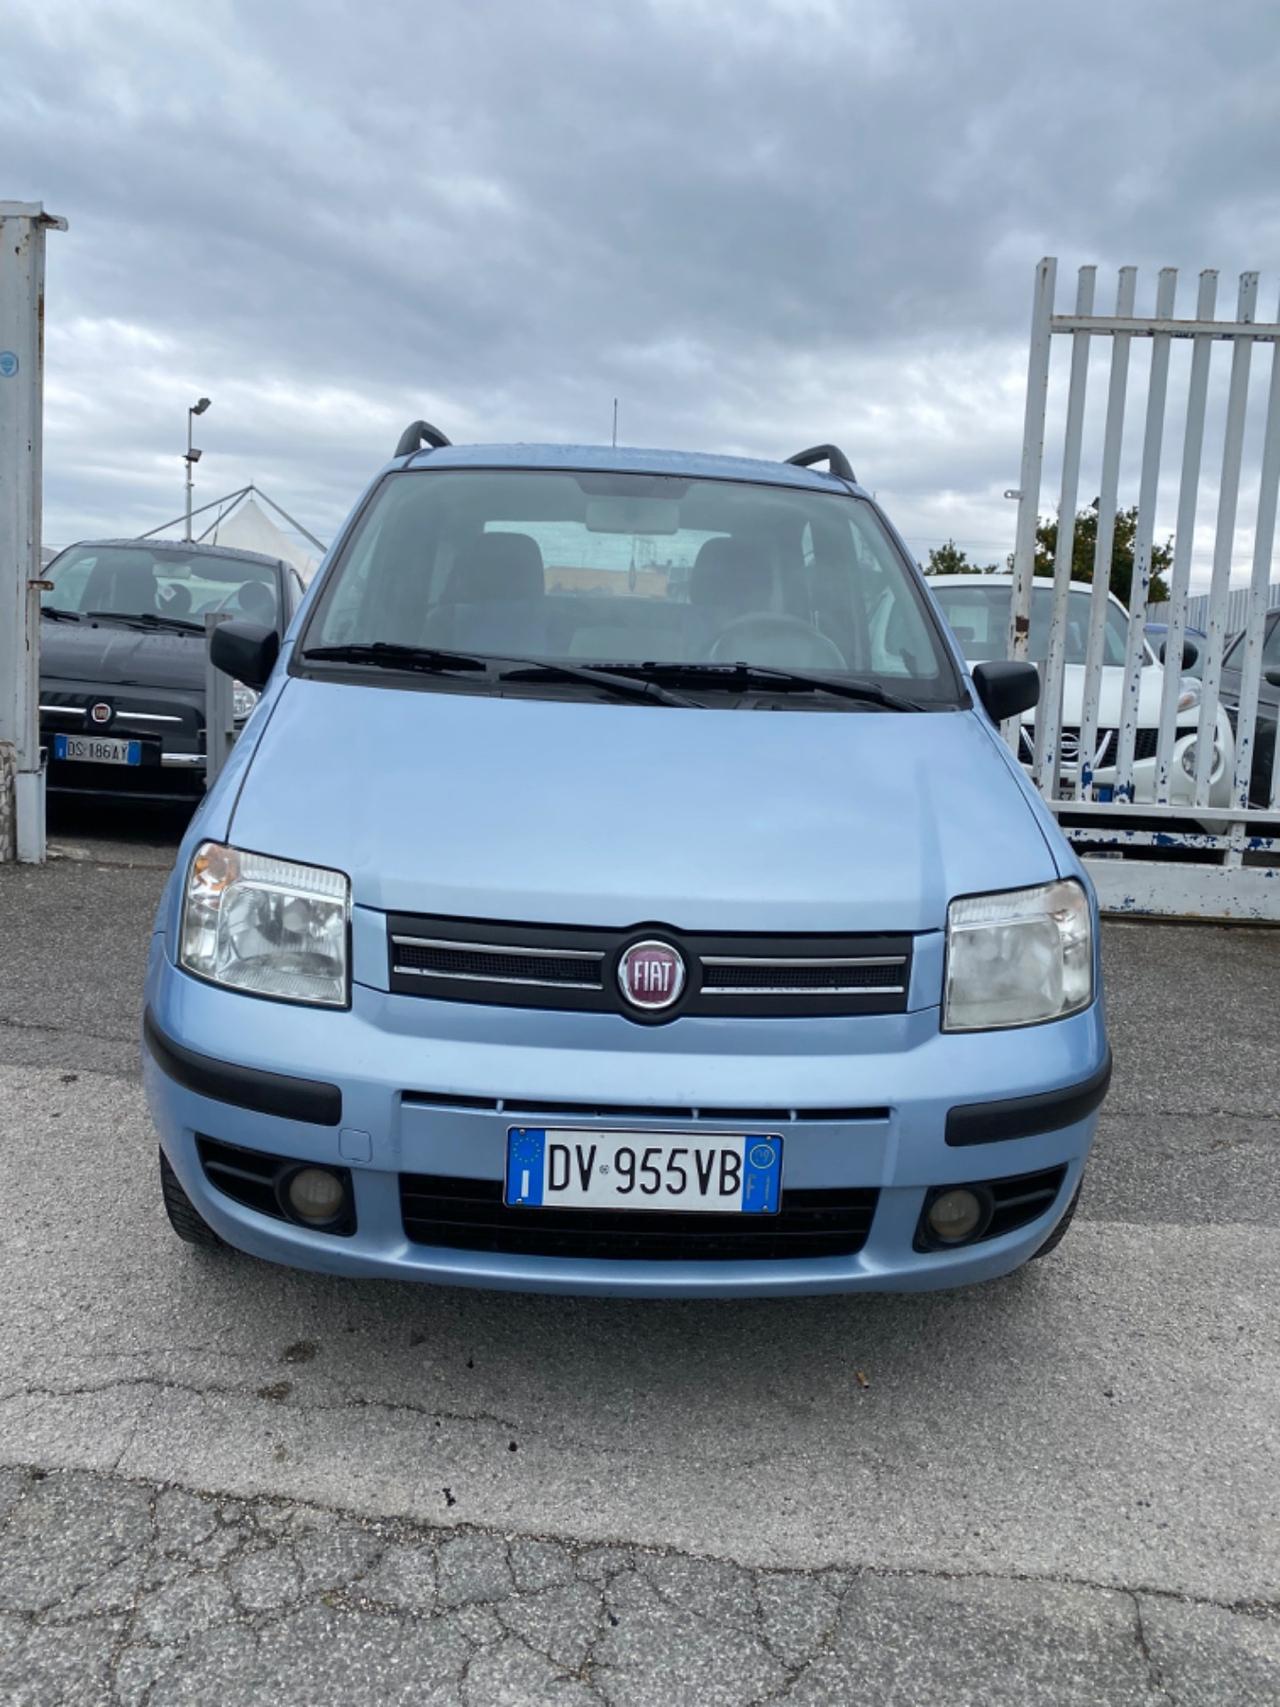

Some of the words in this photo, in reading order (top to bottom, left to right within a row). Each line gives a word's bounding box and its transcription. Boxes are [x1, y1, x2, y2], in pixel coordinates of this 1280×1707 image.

[68, 741, 84, 756] DS
[89, 743, 129, 761] 186AY
[634, 961, 673, 992] FIAT
[548, 1143, 598, 1192] DV
[614, 1146, 743, 1196] 955VB
